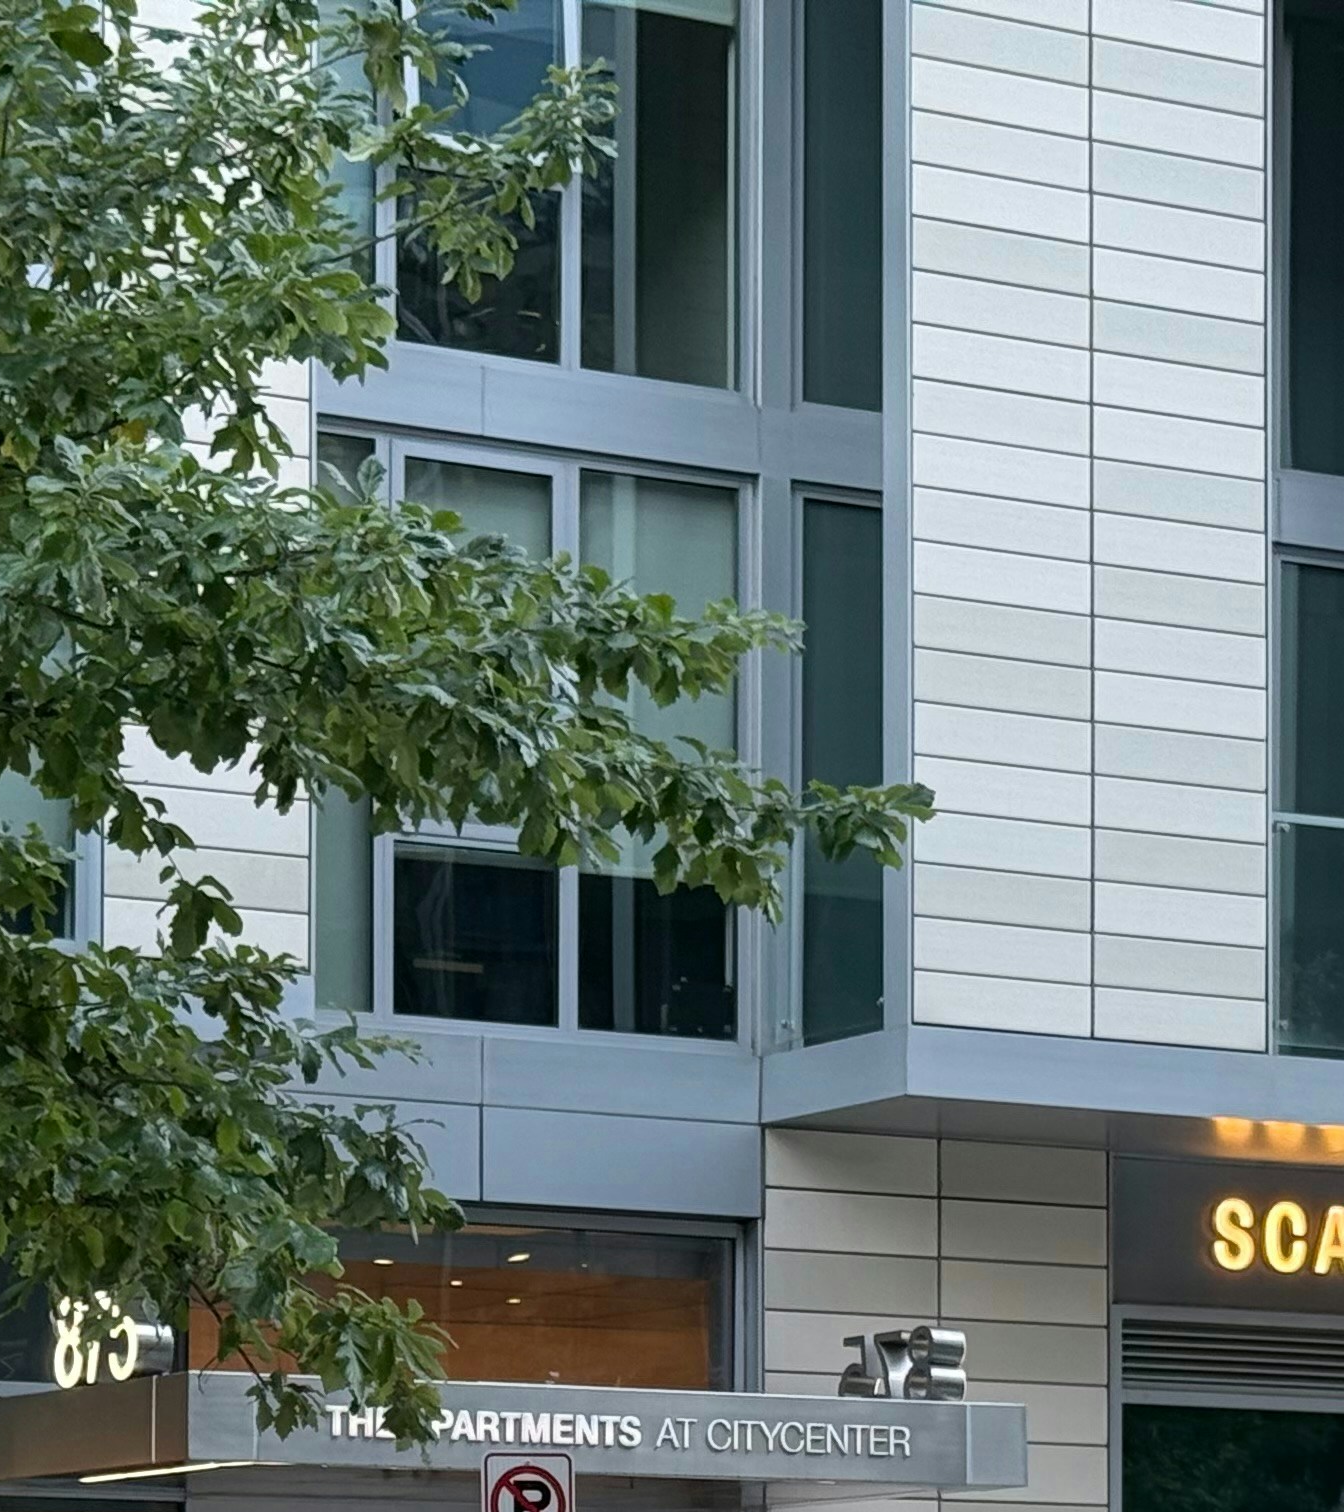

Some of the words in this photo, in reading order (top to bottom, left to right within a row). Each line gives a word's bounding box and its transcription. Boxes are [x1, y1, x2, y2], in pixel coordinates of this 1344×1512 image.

[325, 1405, 398, 1440] THE
[428, 1408, 643, 1448] PARTMENTS
[655, 1416, 698, 1450] AT
[706, 1417, 912, 1458] CITYCENTER
